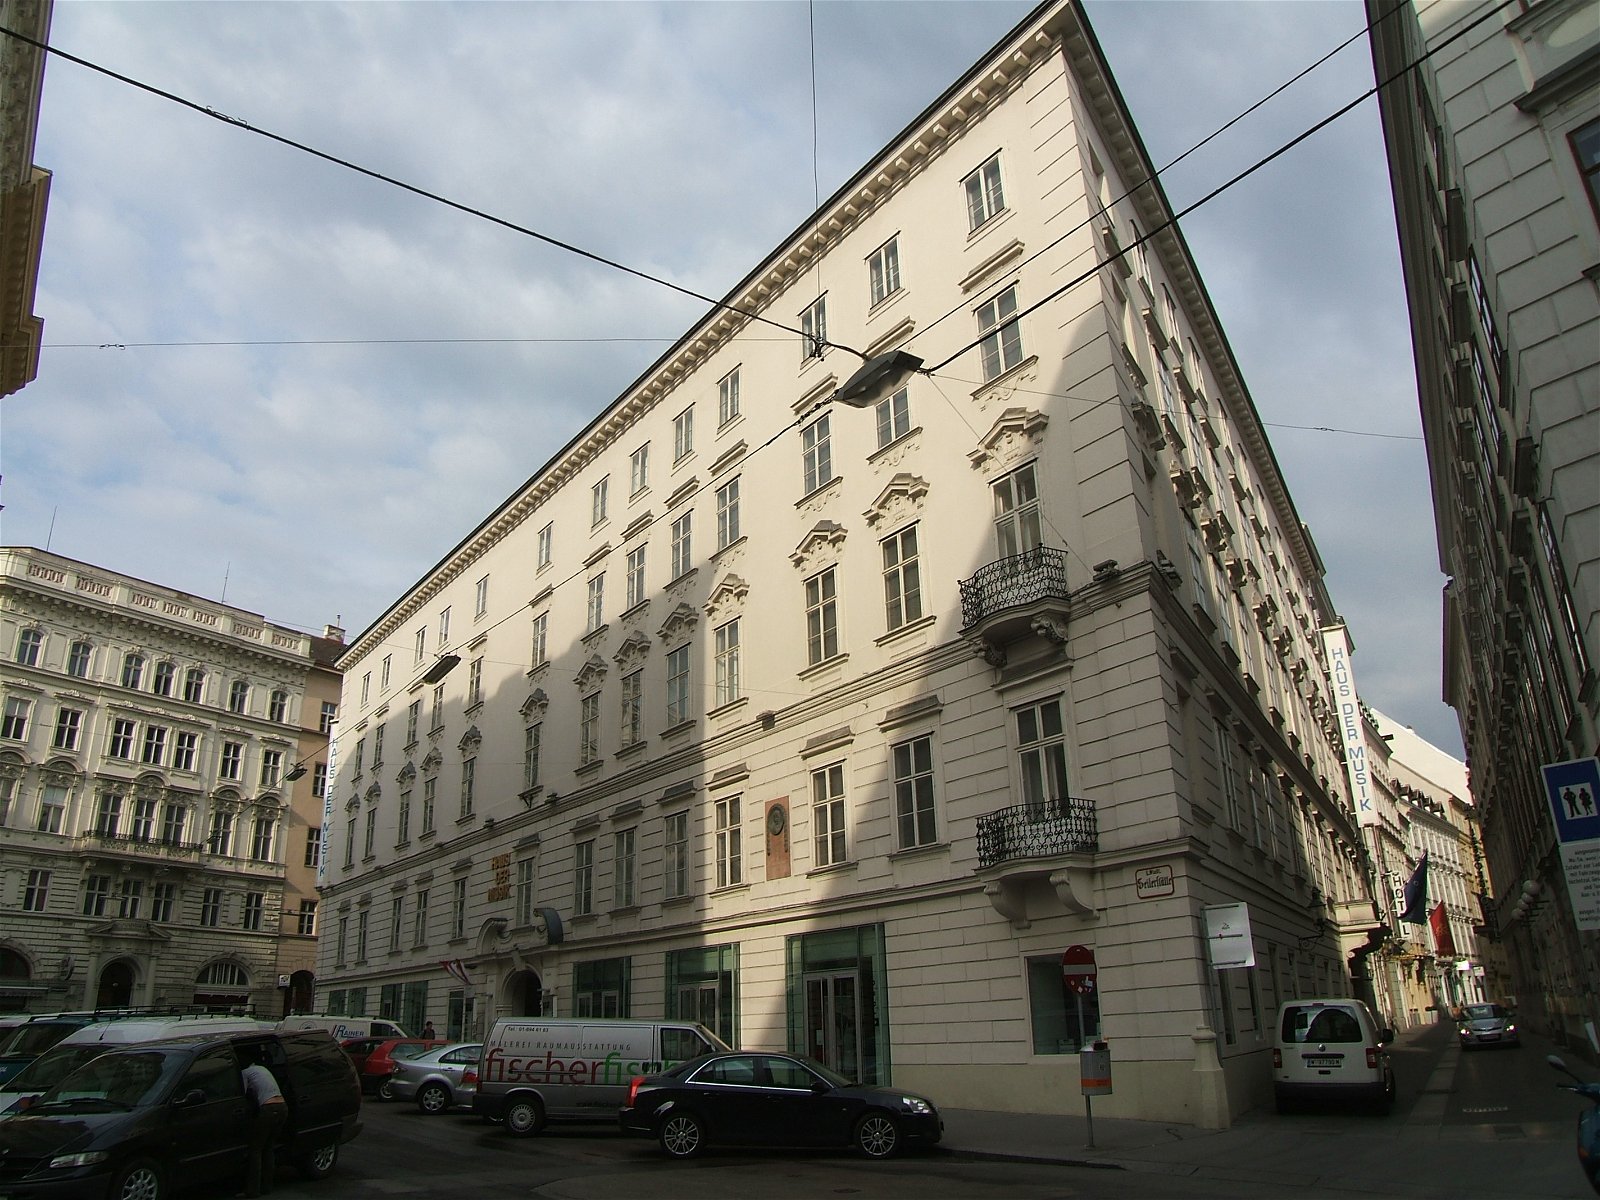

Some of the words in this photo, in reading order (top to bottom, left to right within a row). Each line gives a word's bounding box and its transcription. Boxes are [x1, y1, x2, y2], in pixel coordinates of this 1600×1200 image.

[1331, 647, 1350, 697] HAUS
[1342, 703, 1358, 741] DER
[1348, 746, 1372, 812] MUSIK
[491, 852, 511, 870] HAUS
[496, 868, 510, 885] DER
[1392, 876, 1410, 935] HOTL
[335, 1024, 365, 1038] RAINER
[490, 1040, 531, 1048] MALEREI
[536, 1042, 631, 1051] RAUMAUSSTATTUNG
